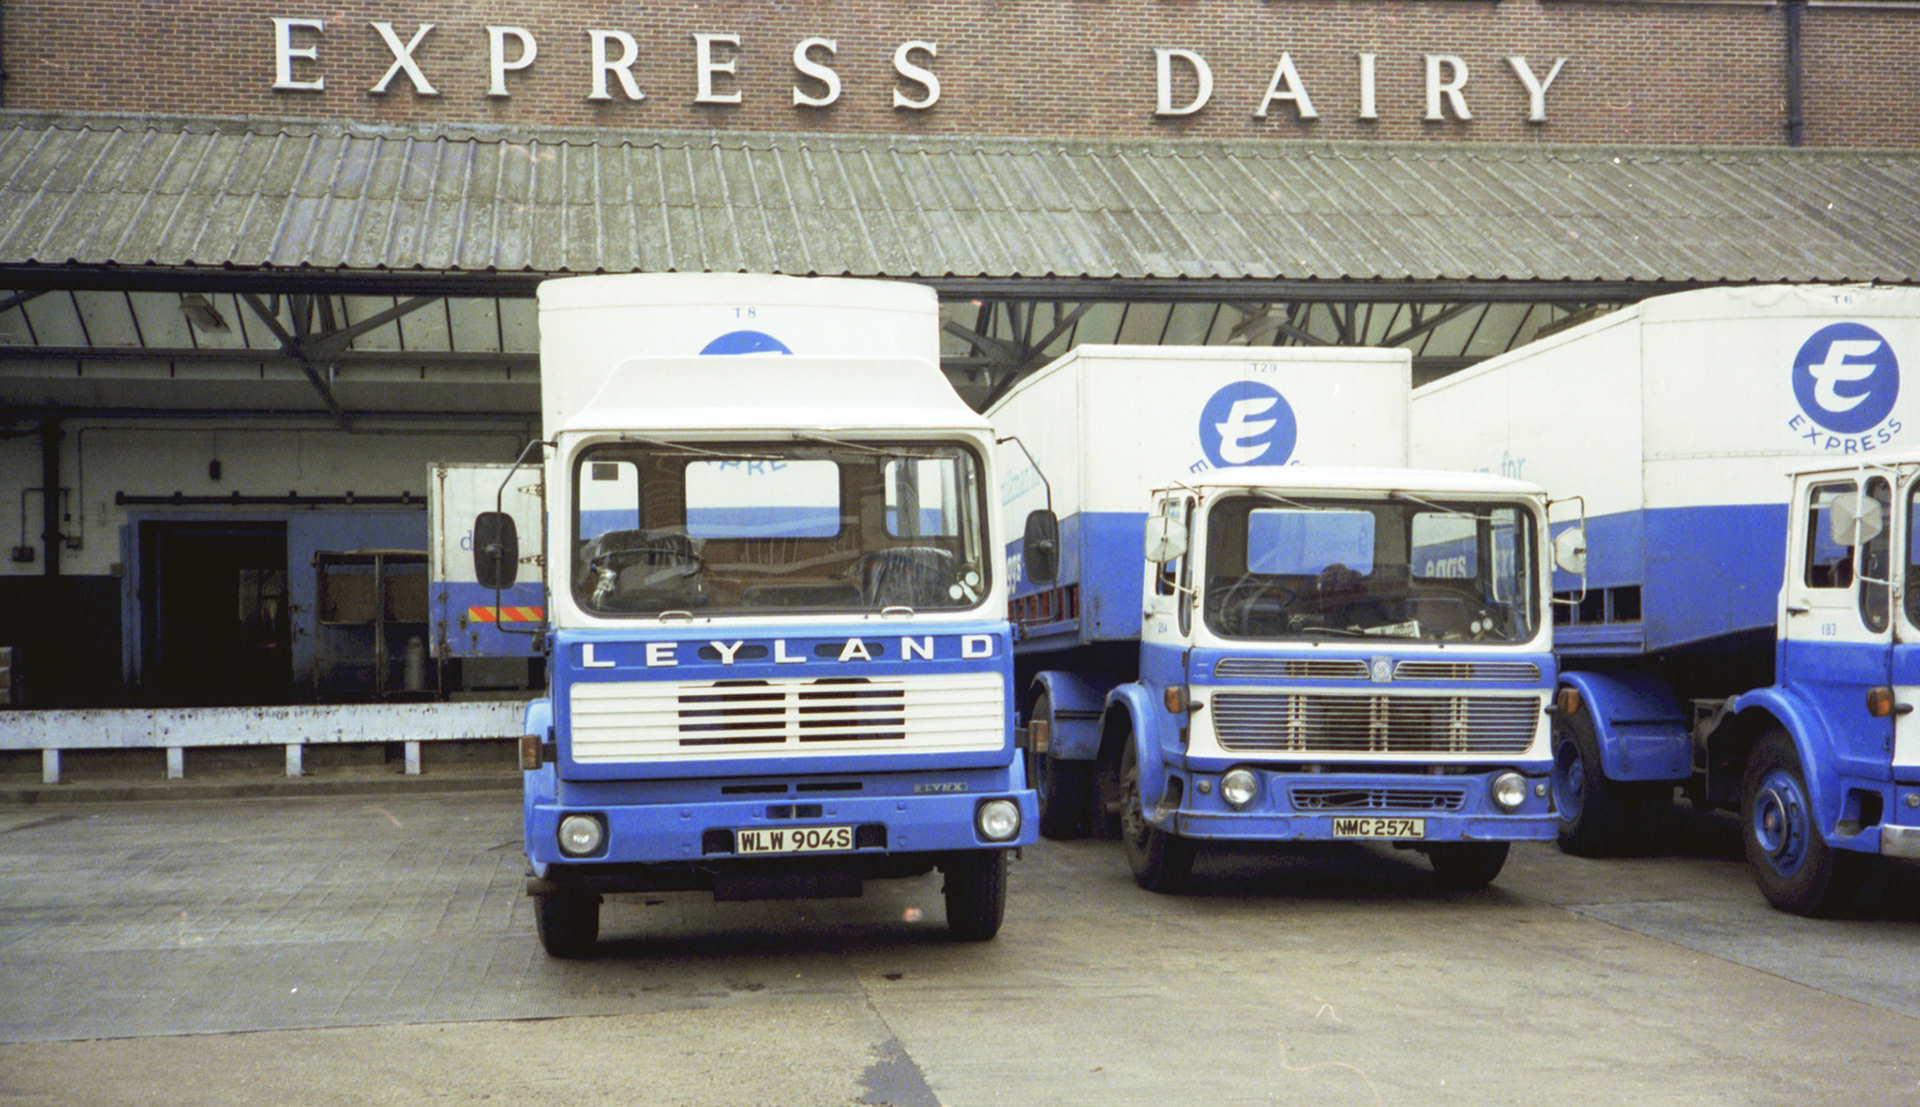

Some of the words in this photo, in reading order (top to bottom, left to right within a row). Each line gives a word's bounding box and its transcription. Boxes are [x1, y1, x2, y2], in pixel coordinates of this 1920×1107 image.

[270, 17, 942, 110] EXPRESS
[1153, 48, 1568, 122] DAIRY
[733, 307, 757, 319] T8
[1788, 414, 1902, 454] EXPRESS
[1821, 623, 1837, 636] 183
[583, 634, 993, 667] LEYLAND
[924, 783, 963, 792] LYNX
[1336, 820, 1370, 836] NMC
[1374, 820, 1422, 836] 257L
[741, 831, 784, 850] WLW
[791, 828, 851, 848] 904S
